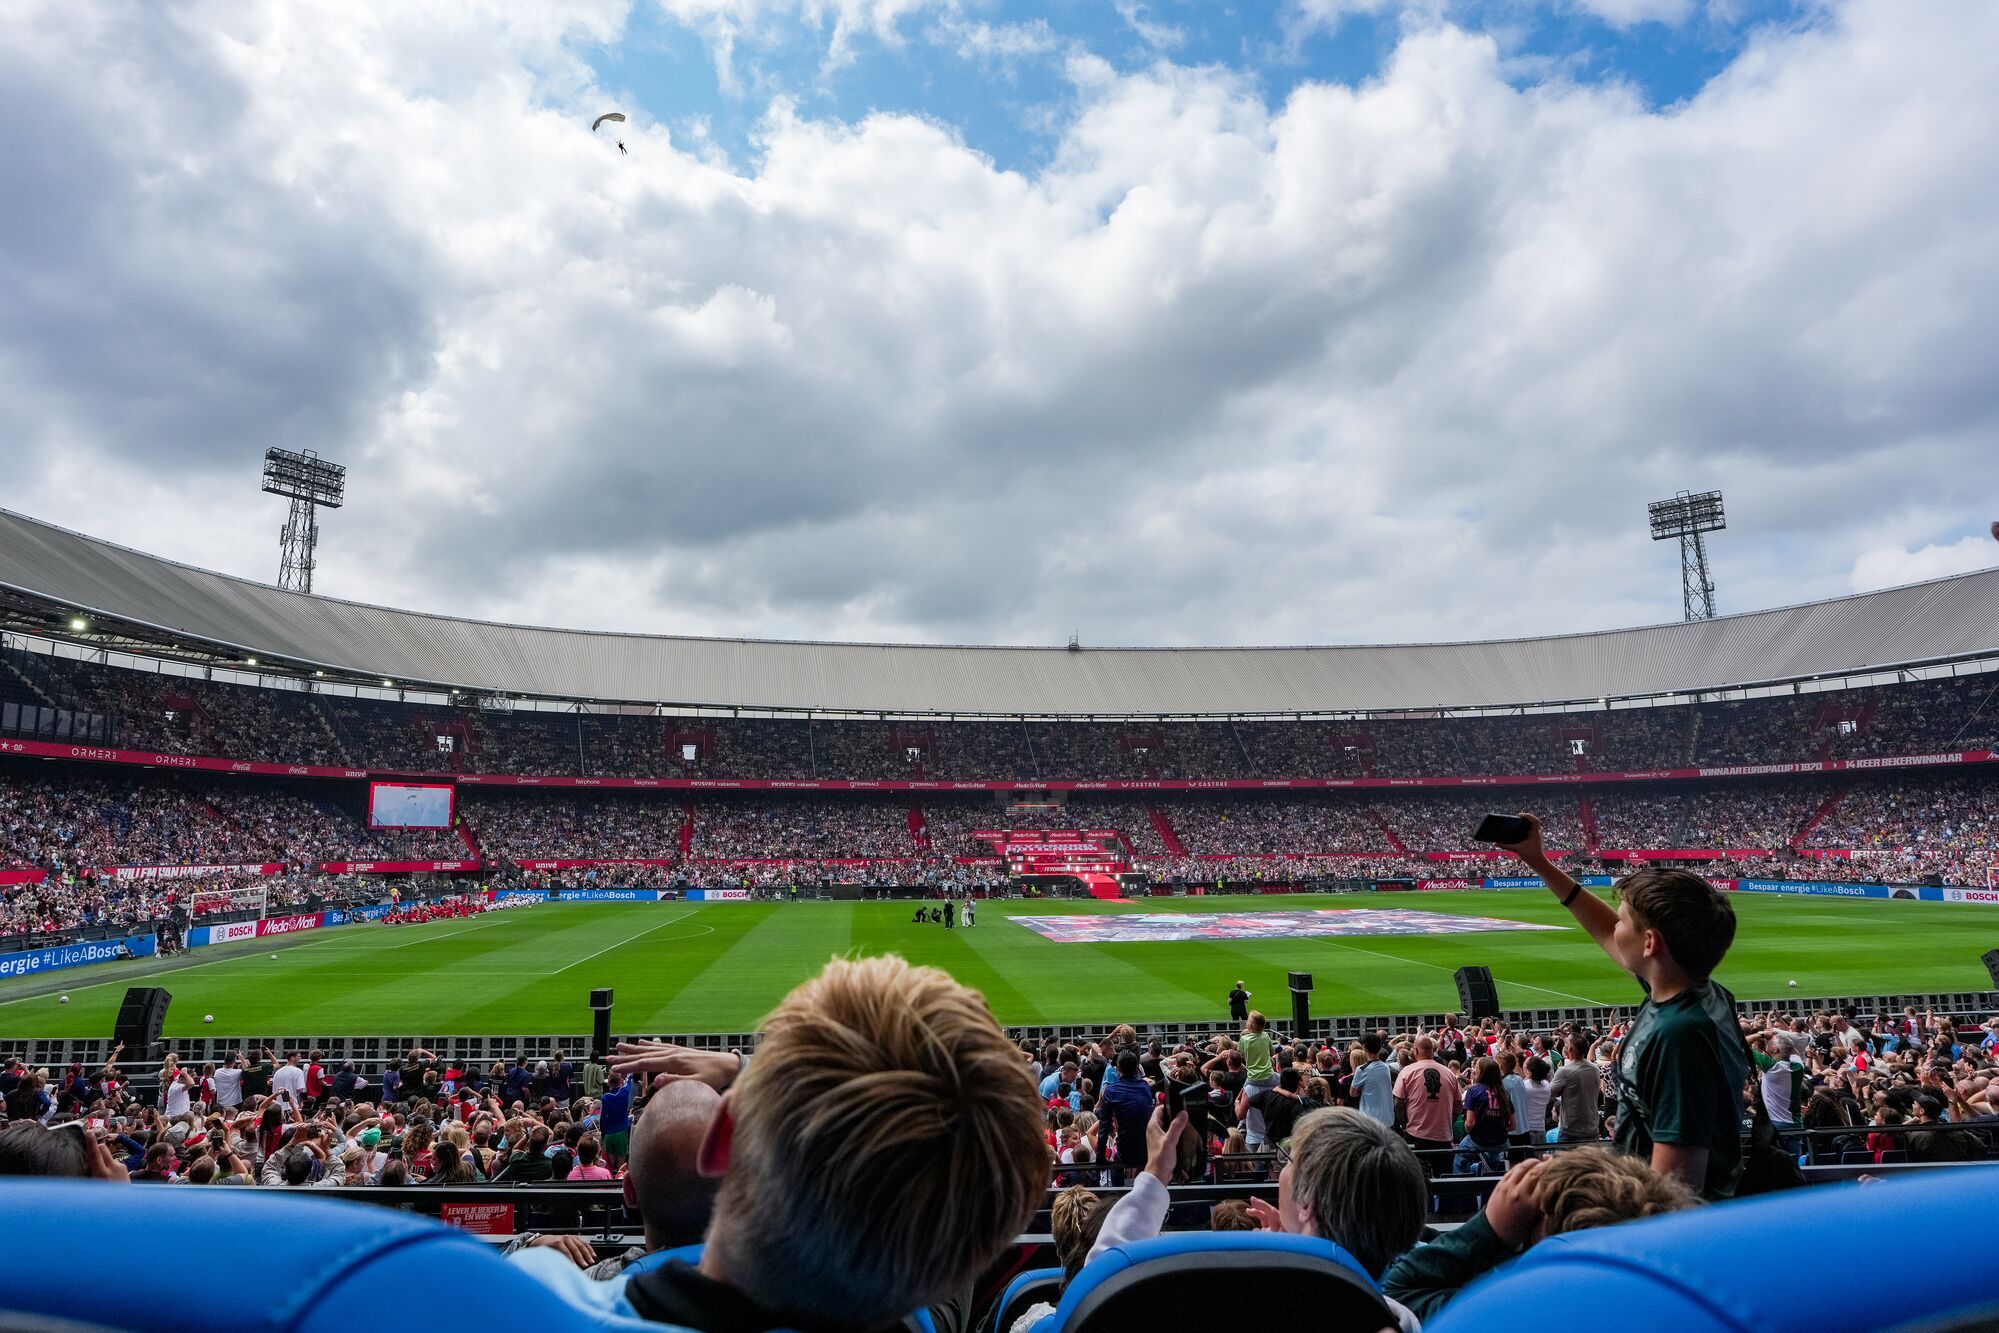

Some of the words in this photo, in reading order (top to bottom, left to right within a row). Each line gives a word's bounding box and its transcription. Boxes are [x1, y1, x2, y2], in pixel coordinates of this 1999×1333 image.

[71, 747, 112, 759] ORMER
[155, 755, 191, 766] ORMER
[1856, 758, 1880, 768] KEER
[1881, 753, 1962, 767] BEKERWINNAAR
[345, 770, 366, 778] univé
[1699, 767, 1742, 776] WINNAAR
[1743, 764, 1793, 774] EUROPACUP
[1801, 762, 1822, 771] 1970
[1494, 880, 1520, 889] Bespaar
[1748, 882, 1778, 892] Bespaar
[1781, 883, 1810, 894] energie
[581, 890, 635, 900] #LikeABosch
[1965, 892, 1998, 901] BOSCH
[228, 924, 253, 938] BOSCH
[43, 944, 119, 966] #LikeABosc
[448, 1207, 470, 1215] LEVER
[477, 1206, 500, 1214] BEKER
[464, 1213, 475, 1221] EN
